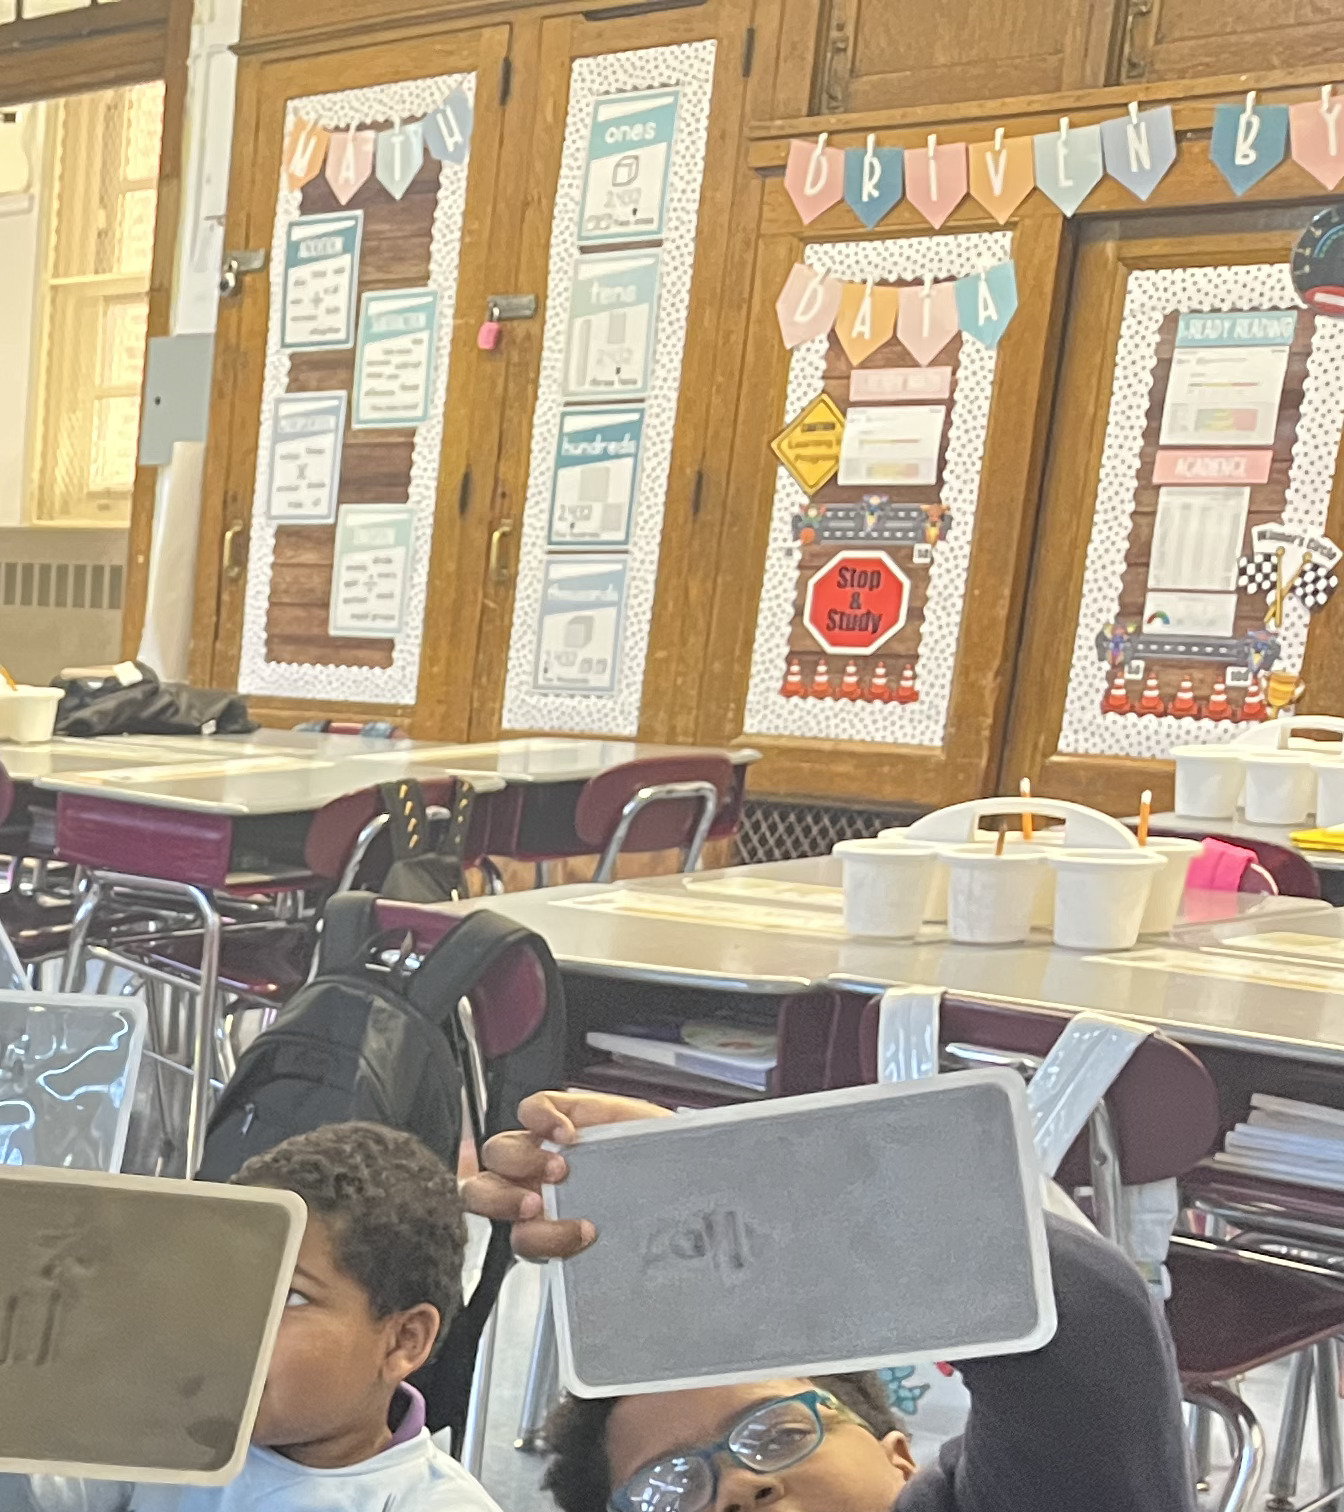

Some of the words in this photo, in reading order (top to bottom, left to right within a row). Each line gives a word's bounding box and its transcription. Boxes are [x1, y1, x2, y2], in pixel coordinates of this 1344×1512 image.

[605, 121, 656, 143] ones
[804, 122, 1151, 201] DRIVEN
[1234, 106, 1343, 166] BY
[589, 281, 637, 304] tens
[794, 272, 998, 341] DATA
[836, 566, 881, 591] Stop
[849, 592, 862, 610] &
[826, 609, 883, 635] Study
